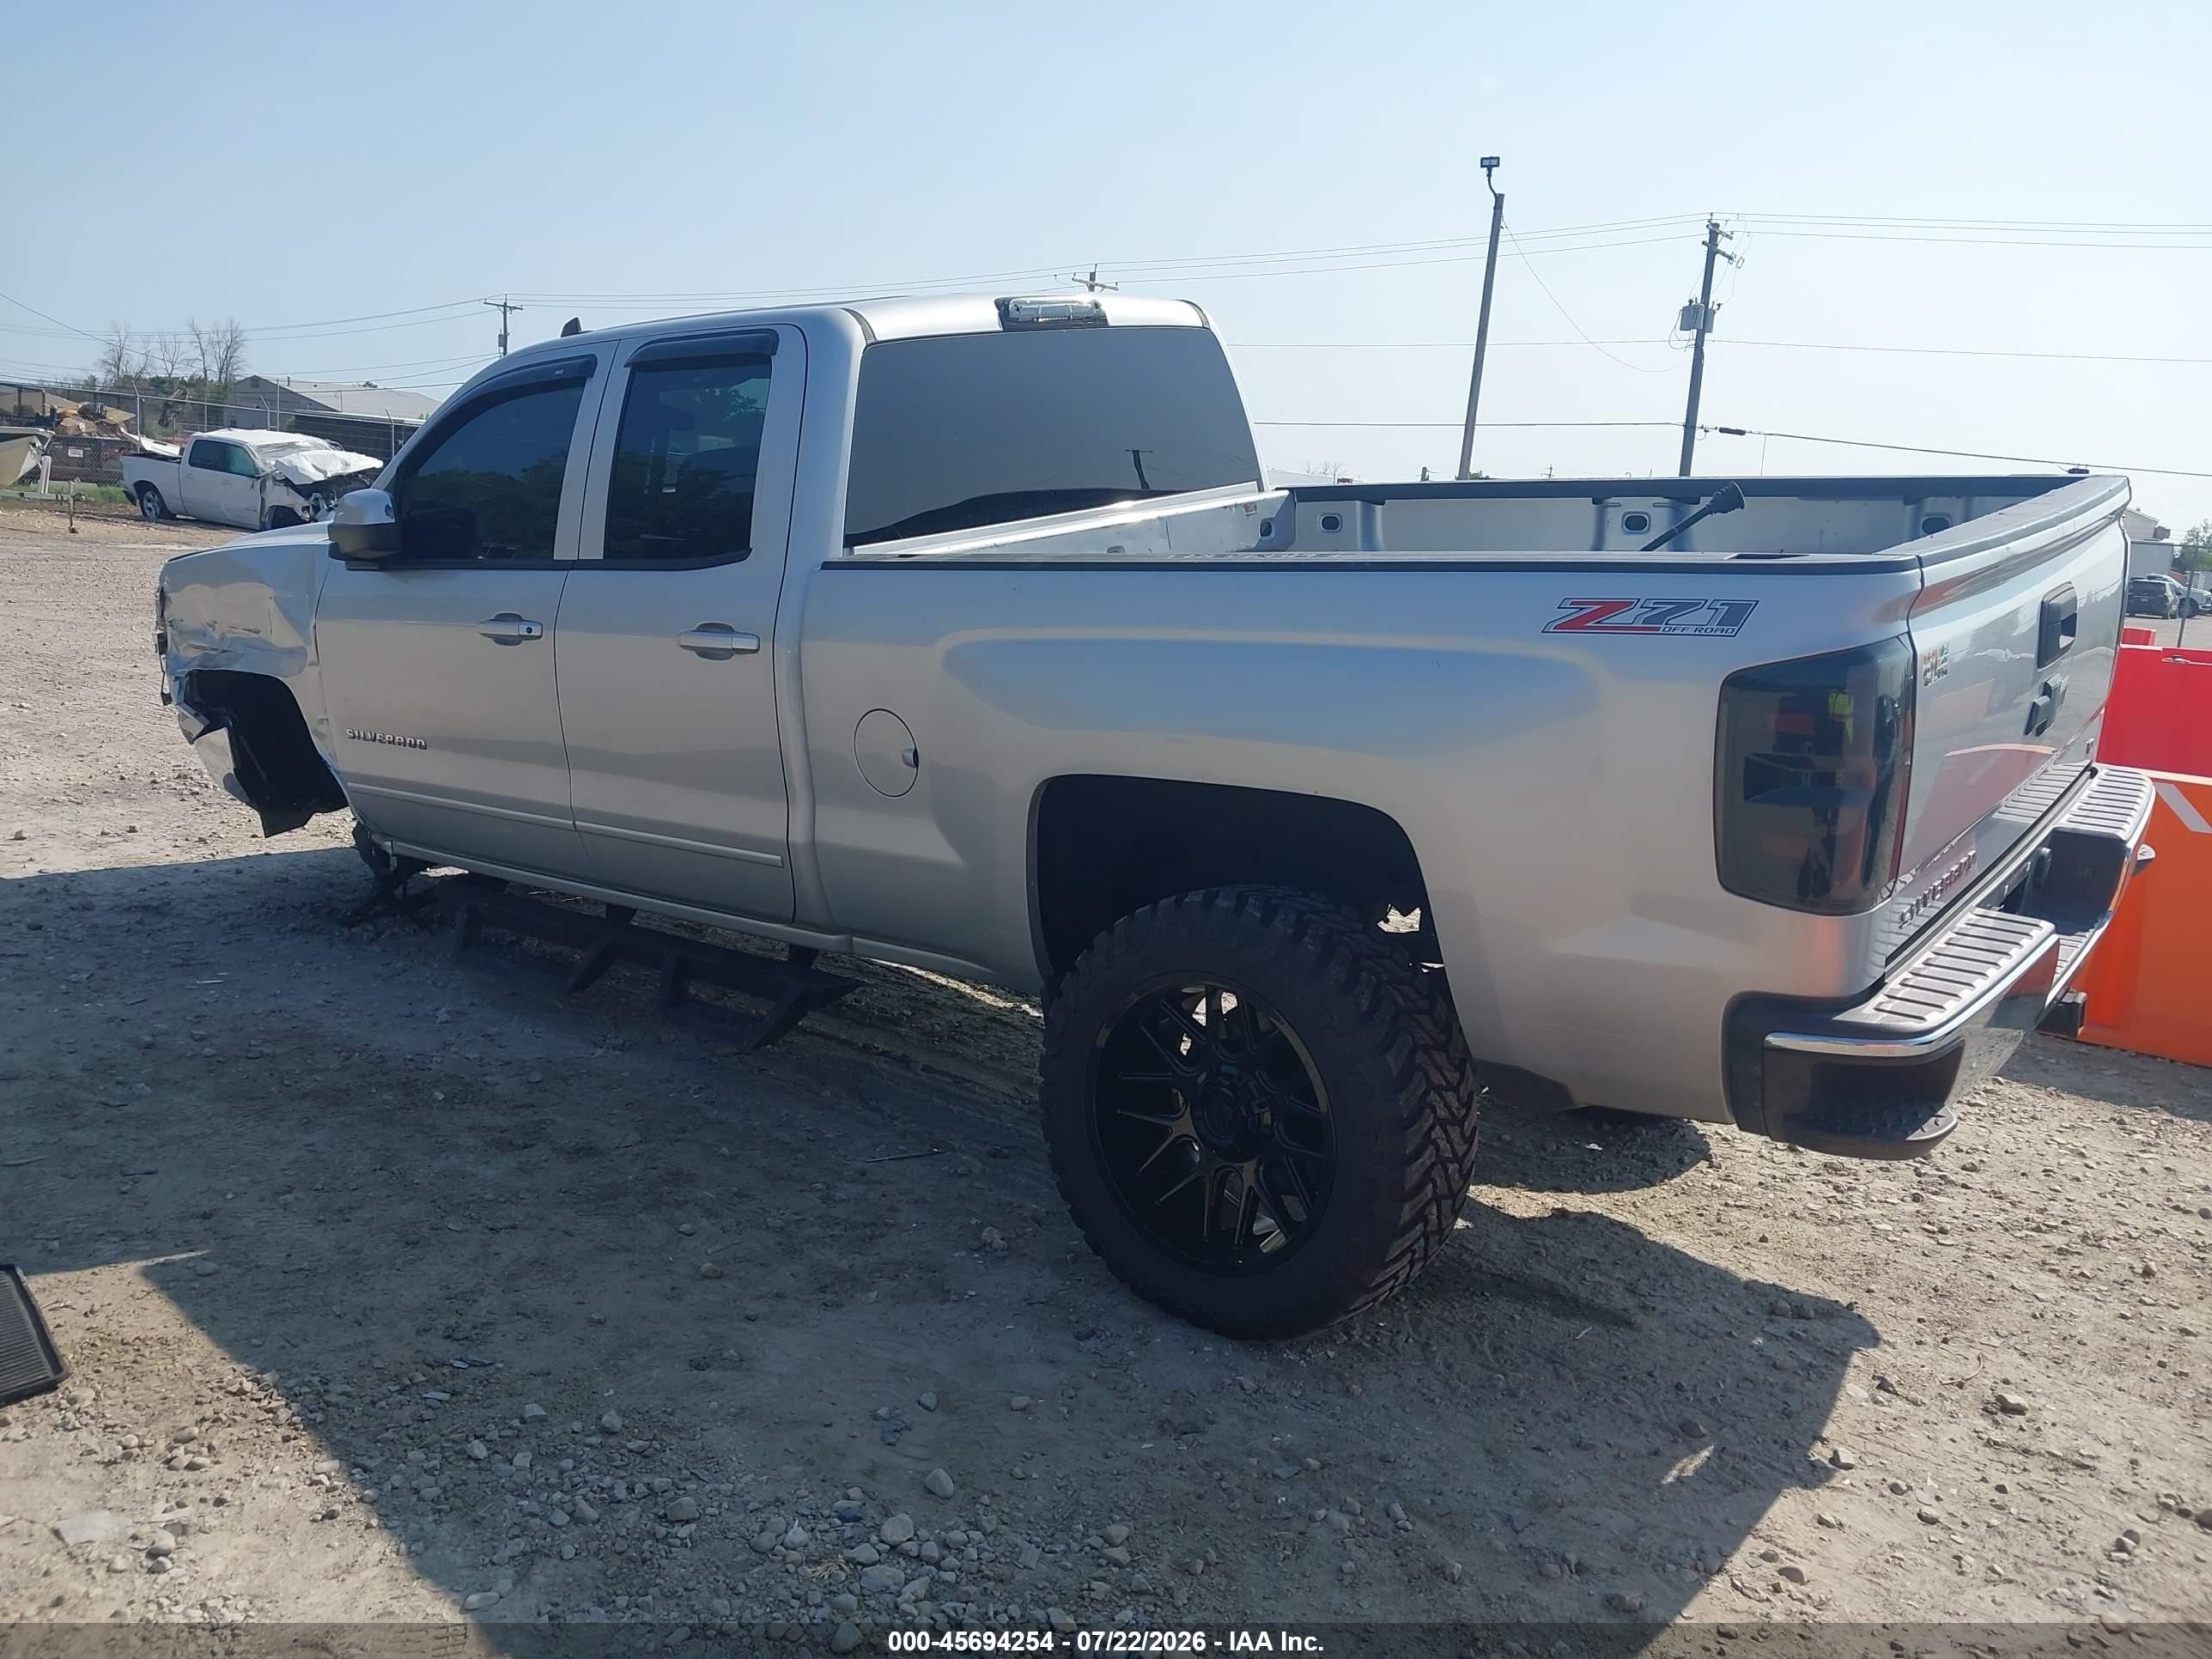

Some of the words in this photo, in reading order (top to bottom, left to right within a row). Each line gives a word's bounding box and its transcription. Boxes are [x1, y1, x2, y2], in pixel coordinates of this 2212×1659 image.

[1541, 598, 1759, 635] Z71
[1662, 625, 1692, 634] OFF
[1693, 626, 1735, 635] ROAD
[346, 728, 428, 750] SILVERADO
